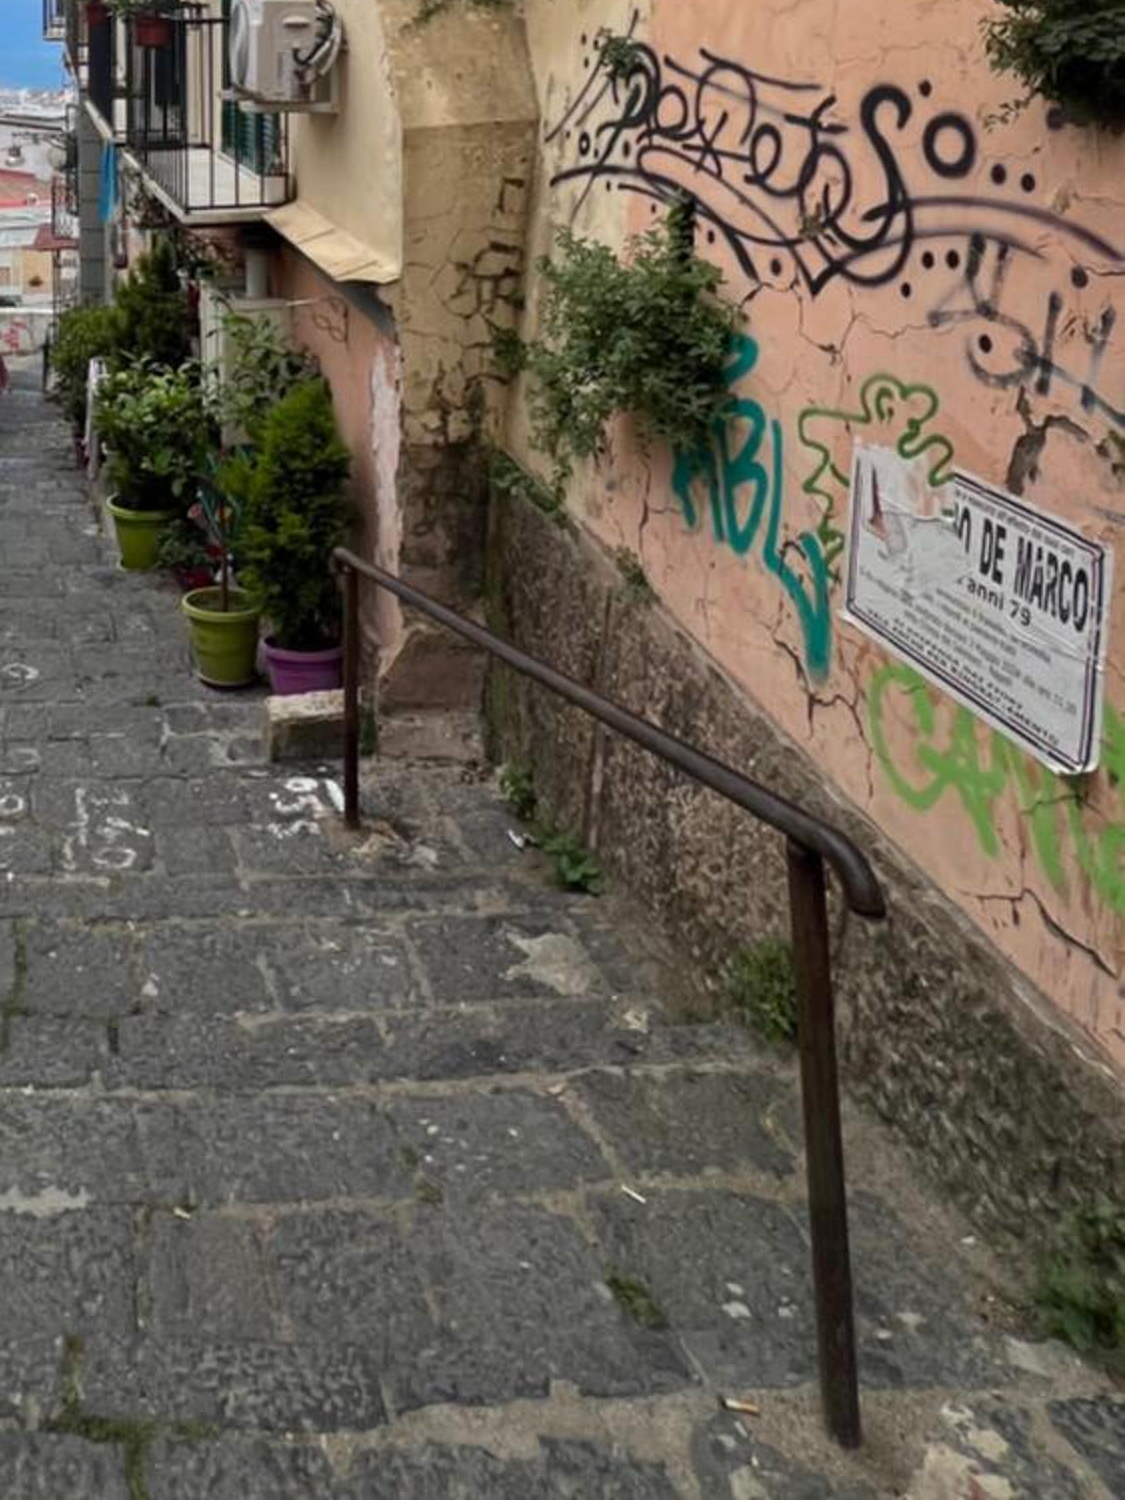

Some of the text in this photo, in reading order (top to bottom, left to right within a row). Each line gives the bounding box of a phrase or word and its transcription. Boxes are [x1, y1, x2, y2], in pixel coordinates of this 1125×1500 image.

[966, 576, 1032, 627] anni 79
[979, 517, 1007, 586] DE
[1013, 535, 1089, 633] MARCO
